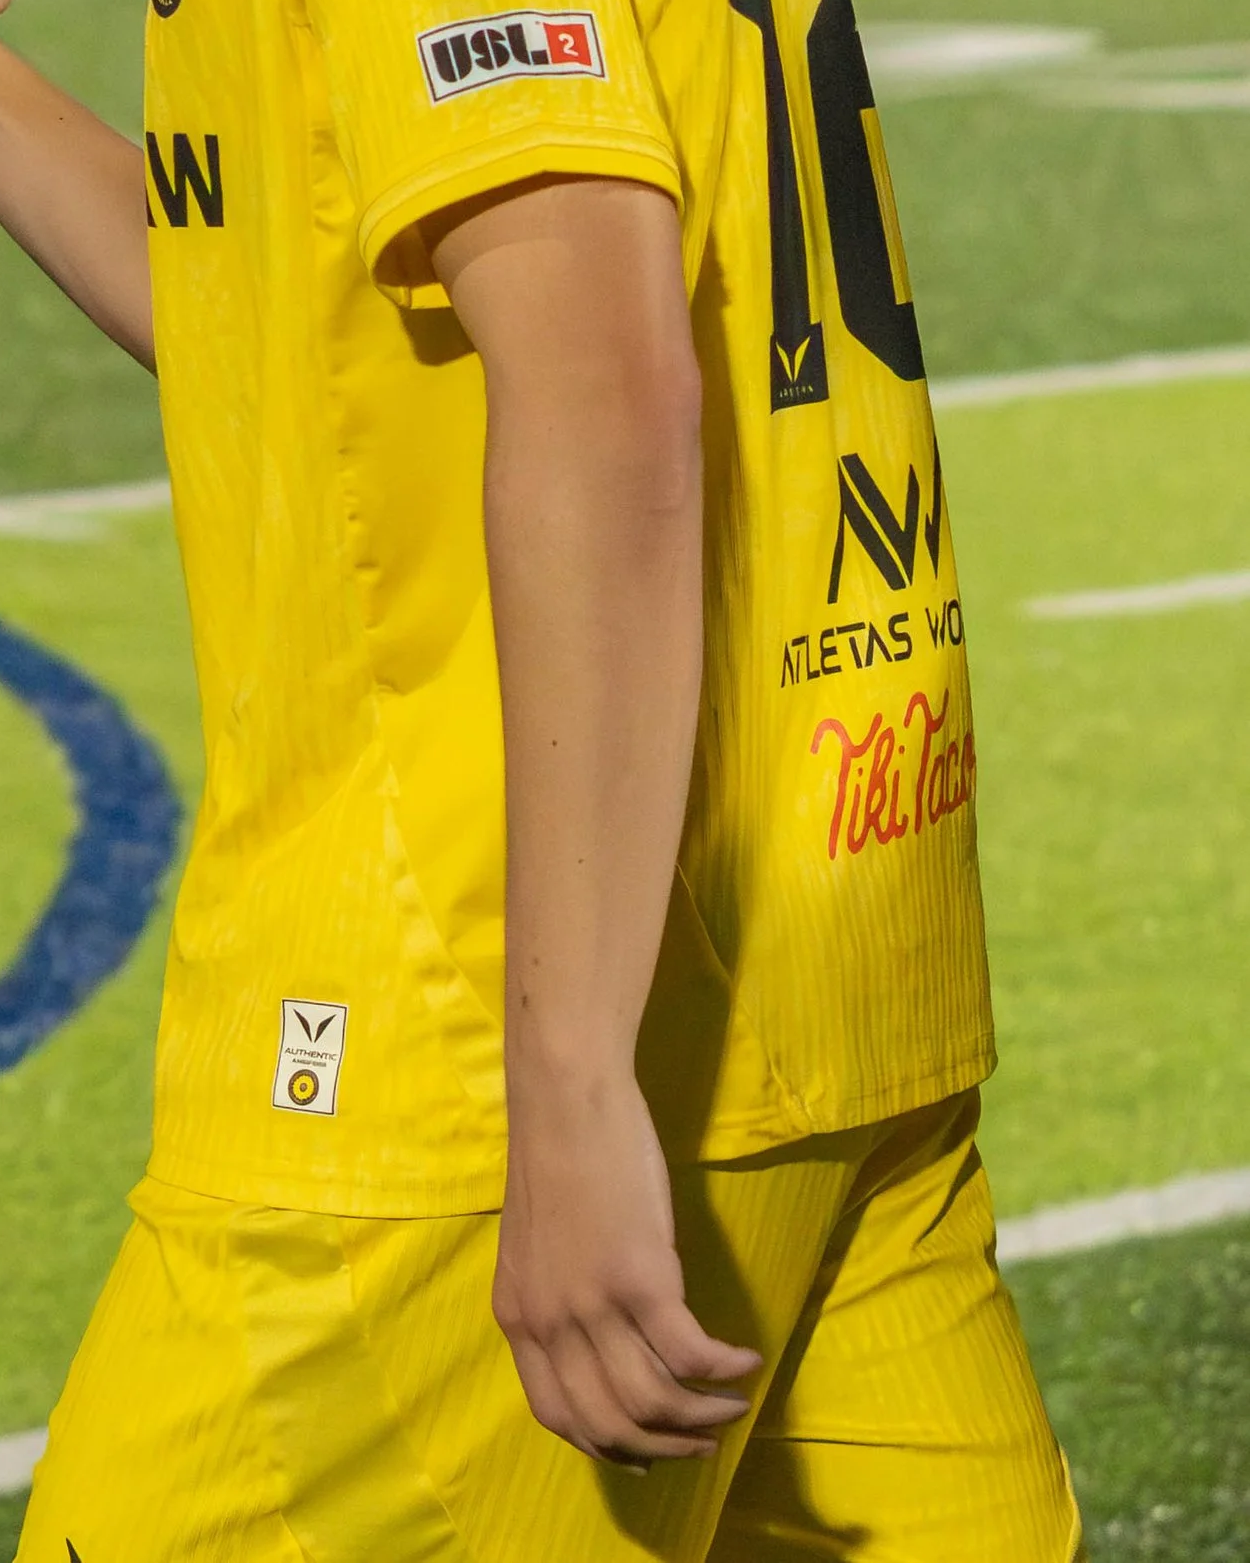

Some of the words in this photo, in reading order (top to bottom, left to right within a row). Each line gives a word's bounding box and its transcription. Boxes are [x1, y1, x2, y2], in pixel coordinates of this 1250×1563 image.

[430, 22, 550, 84] USL
[557, 32, 579, 57] 2
[145, 131, 225, 228] W
[780, 612, 914, 688] ATLETAS
[924, 599, 965, 650] WO
[810, 712, 909, 861] Tiki
[284, 1046, 338, 1062] AUTHENTIC
